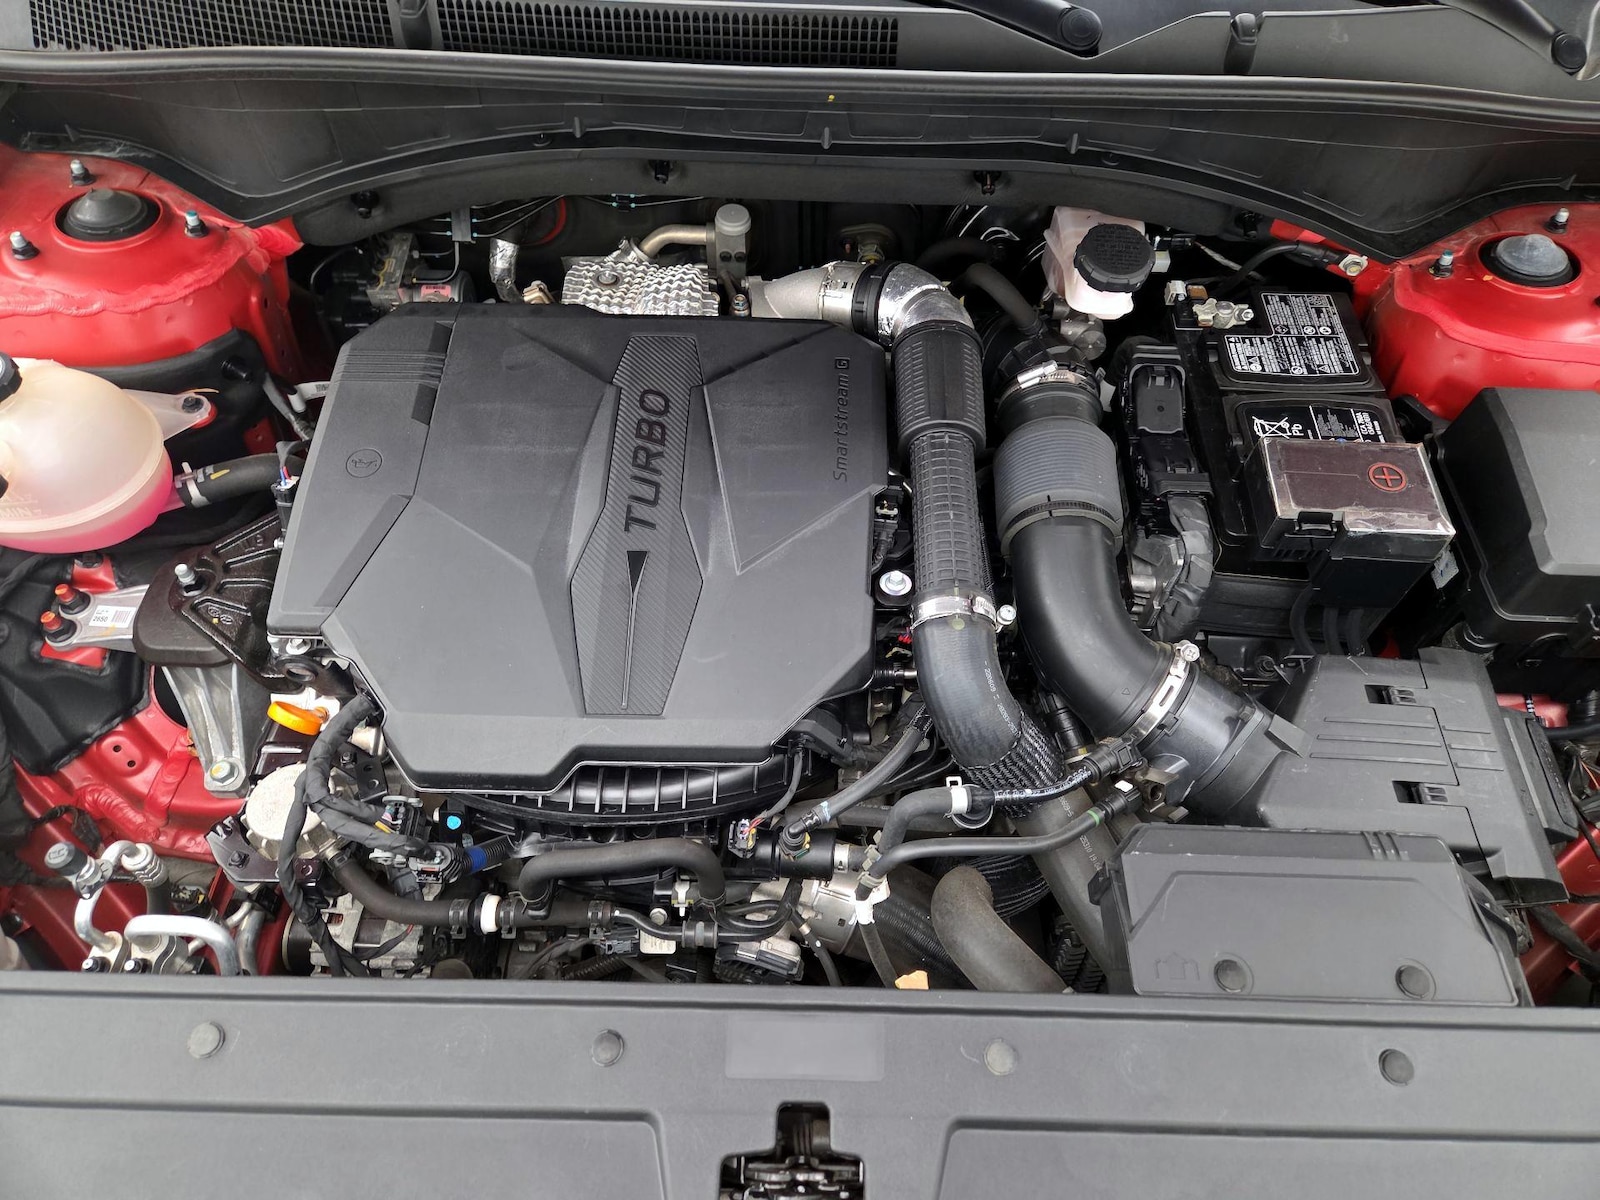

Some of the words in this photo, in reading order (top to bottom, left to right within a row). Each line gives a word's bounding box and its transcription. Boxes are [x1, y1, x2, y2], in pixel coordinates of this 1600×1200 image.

[624, 389, 670, 532] TURBO
[832, 374, 849, 482] Smartstream
[1291, 423, 1304, 436] Pb
